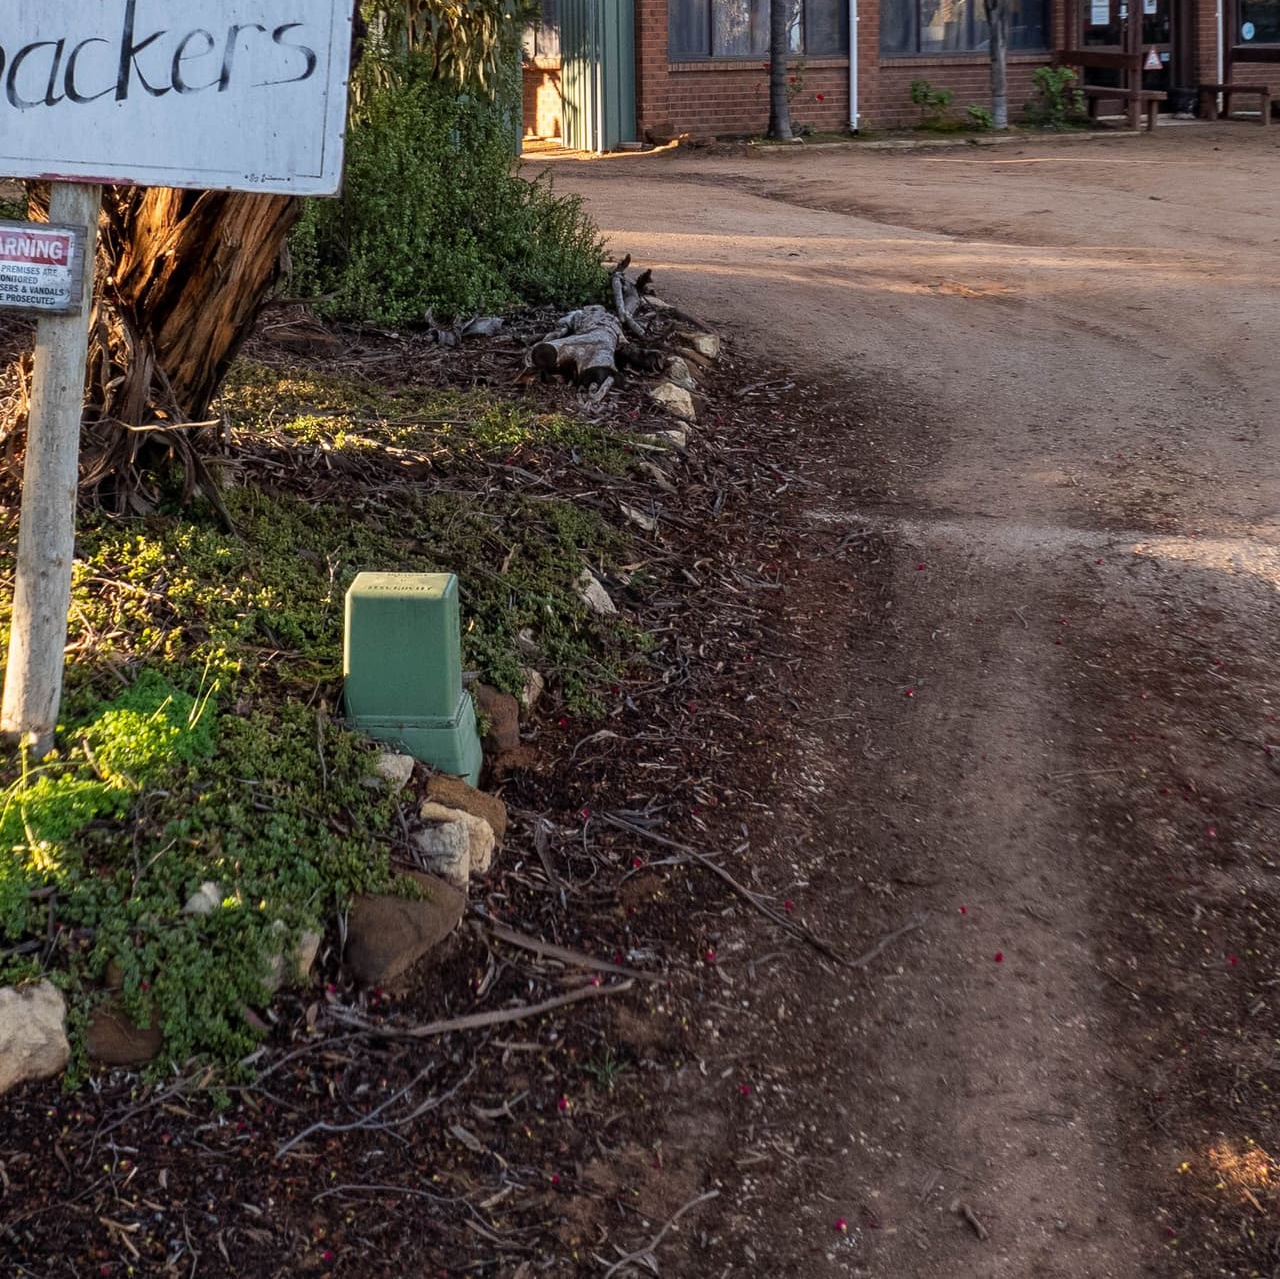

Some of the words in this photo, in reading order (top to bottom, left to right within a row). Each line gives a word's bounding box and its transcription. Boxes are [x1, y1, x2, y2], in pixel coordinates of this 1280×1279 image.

[1, 264, 40, 276] PREMISES
[42, 267, 58, 277] ARE
[21, 285, 27, 293] &
[29, 286, 65, 297] VANDALS
[6, 294, 56, 305] PROSECUTED
